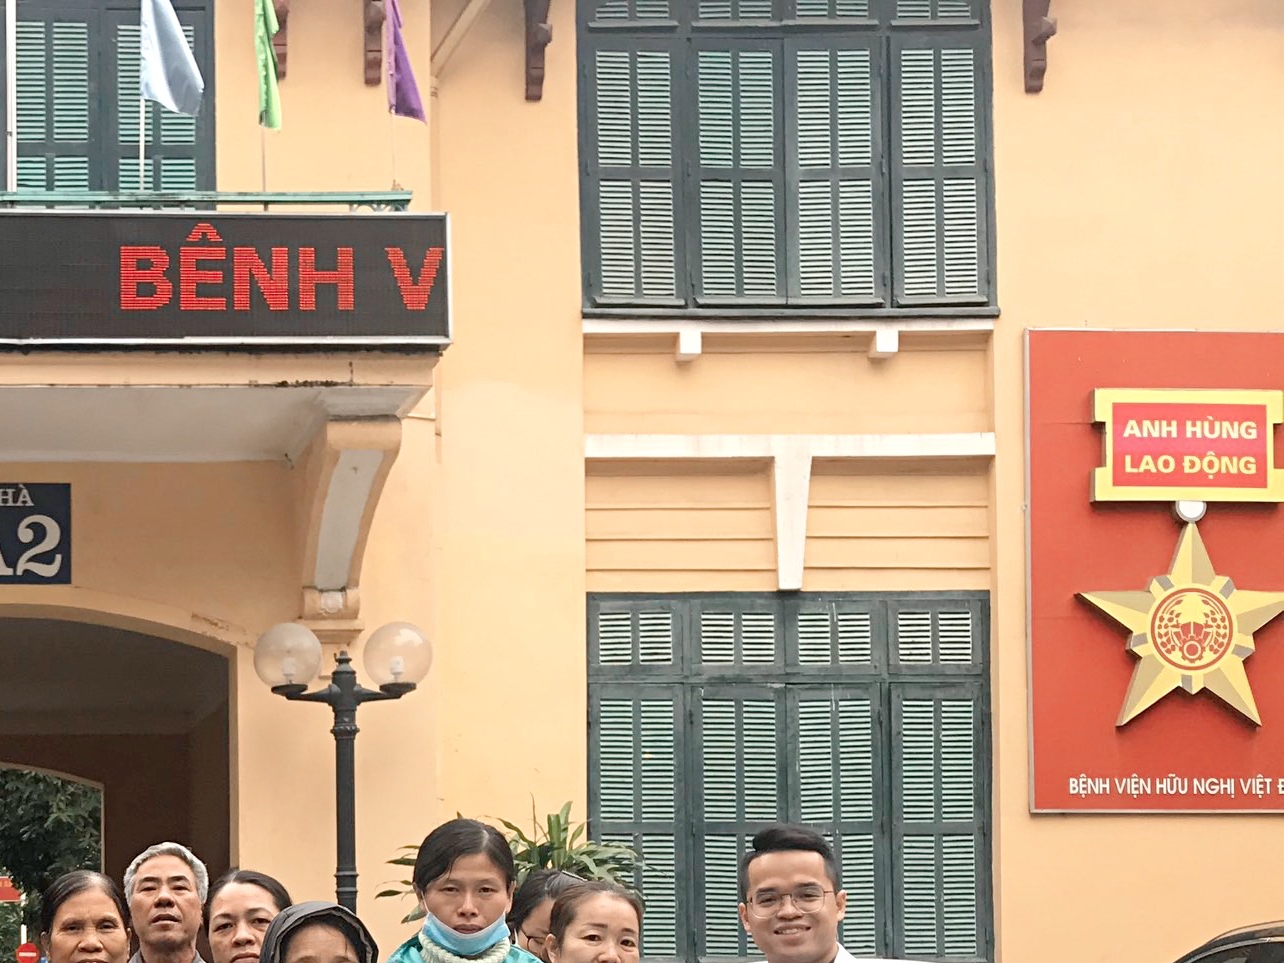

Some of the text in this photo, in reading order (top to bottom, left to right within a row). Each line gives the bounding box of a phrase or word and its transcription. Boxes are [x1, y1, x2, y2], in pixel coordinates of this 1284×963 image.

[1122, 415, 1258, 440] ANH HÙNG
[1124, 450, 1257, 480] LAO ĐỘNG
[1069, 773, 1110, 799] BỆNH
[1115, 773, 1152, 799] VIỆN
[1155, 773, 1189, 795] HỮU
[1193, 777, 1236, 799] NGHỊ
[1239, 773, 1273, 799] VIỆT
